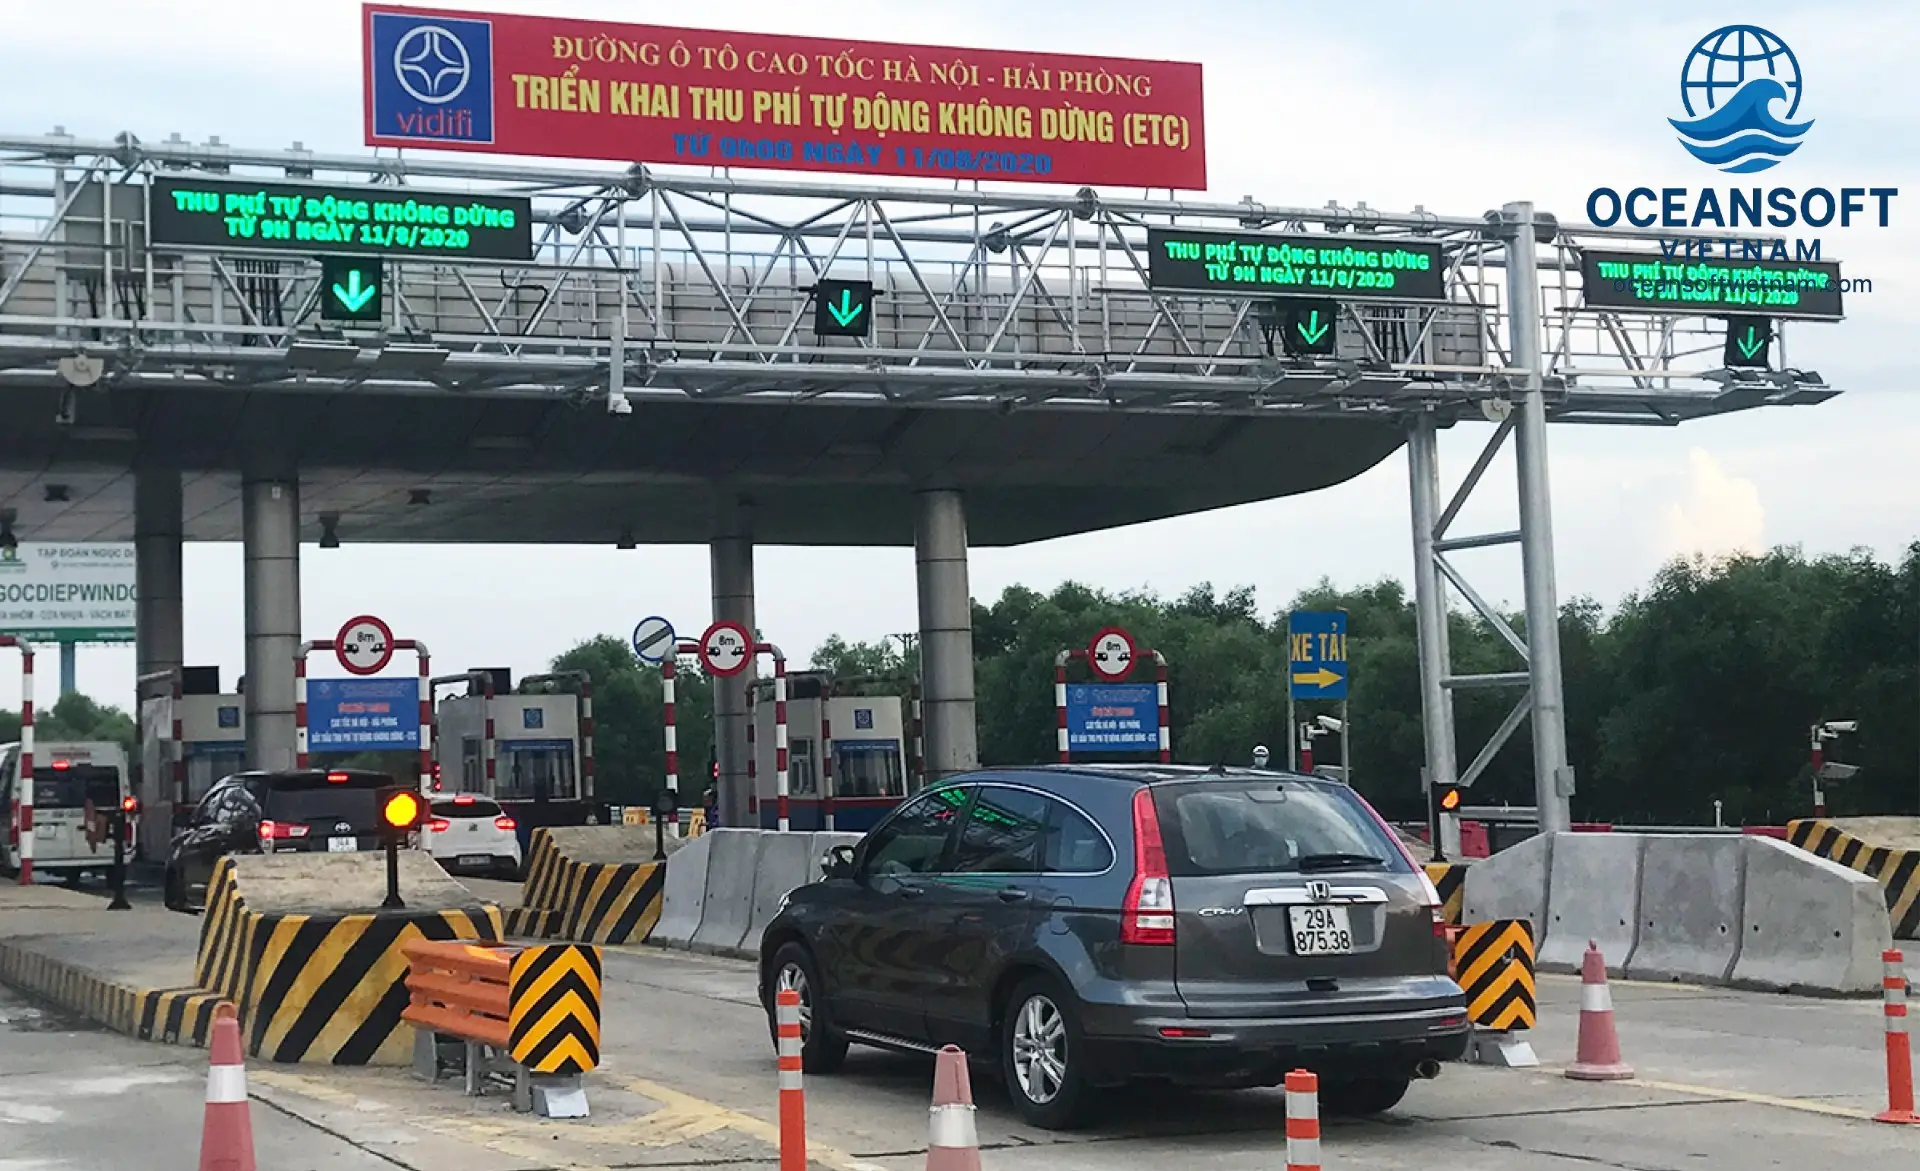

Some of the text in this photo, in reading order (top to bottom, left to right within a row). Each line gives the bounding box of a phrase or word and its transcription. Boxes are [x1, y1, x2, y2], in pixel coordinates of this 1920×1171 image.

[552, 33, 660, 66] ĐƯỜNG
[668, 40, 691, 68] Ô
[699, 43, 739, 71] TÔ
[747, 51, 808, 76] CAO
[816, 49, 875, 80] TỐC
[883, 56, 922, 84] HÀ
[930, 60, 980, 93] NỘI
[1003, 63, 1050, 92] HẢI
[1059, 67, 1152, 97] PHÒNG
[396, 107, 473, 137] vidifi
[511, 64, 1191, 150] TRIỂN KHAI THU PHÍ TỰ ĐỘNG KHÔNG DỪNG (ETC)
[673, 131, 712, 155] TỪ
[803, 139, 882, 165] NGÀY
[895, 146, 1052, 174] 11/08/2020
[171, 190, 515, 229] THU PHÍ TỰ ĐỘNG KHÔNG DỪNG
[224, 215, 470, 248] TỪ 9H NGÀY 11/8/2020
[1165, 240, 1429, 270] THU PHÍ TỰ ĐỘNG KHÔNG DỪNG
[1598, 262, 1628, 278] THU
[1205, 261, 1394, 288] TỪ 9H NGÀY 11/8/2020
[718, 635, 736, 646] 8m
[1106, 641, 1121, 651] 8m
[1291, 621, 1347, 661] XE TẢI
[1304, 909, 1336, 929] 29A
[1296, 931, 1350, 951] 875.38
